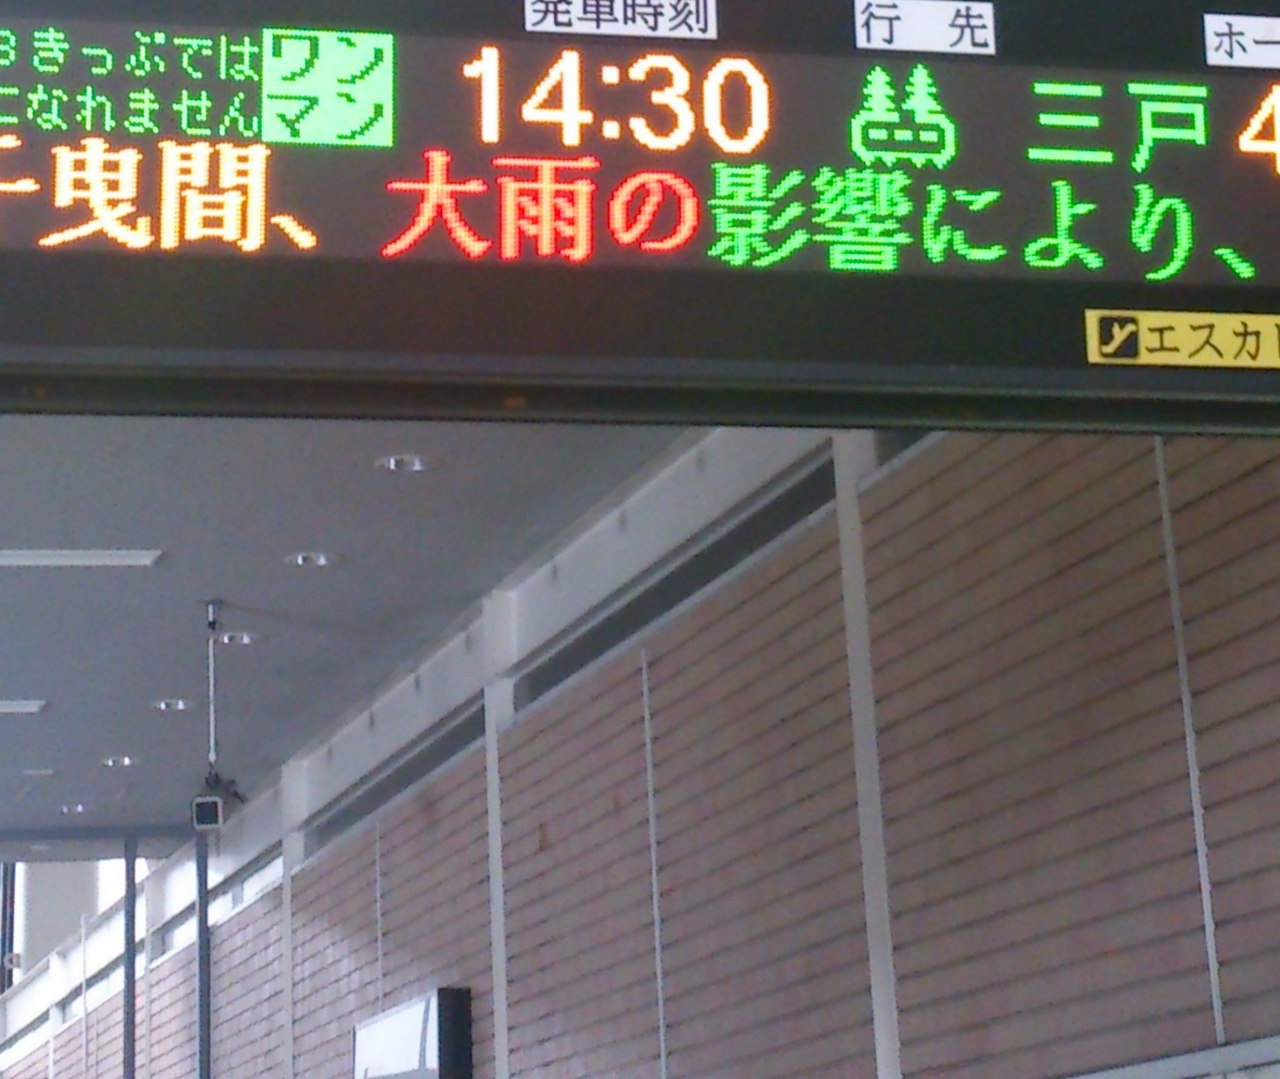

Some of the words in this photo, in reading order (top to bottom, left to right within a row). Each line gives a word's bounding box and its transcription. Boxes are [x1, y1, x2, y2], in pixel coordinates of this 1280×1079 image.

[860, 1, 990, 49] 行先
[271, 31, 386, 84] ワン
[266, 90, 386, 140] マン
[462, 46, 772, 154] 14:30
[1026, 80, 1212, 173] 三戸
